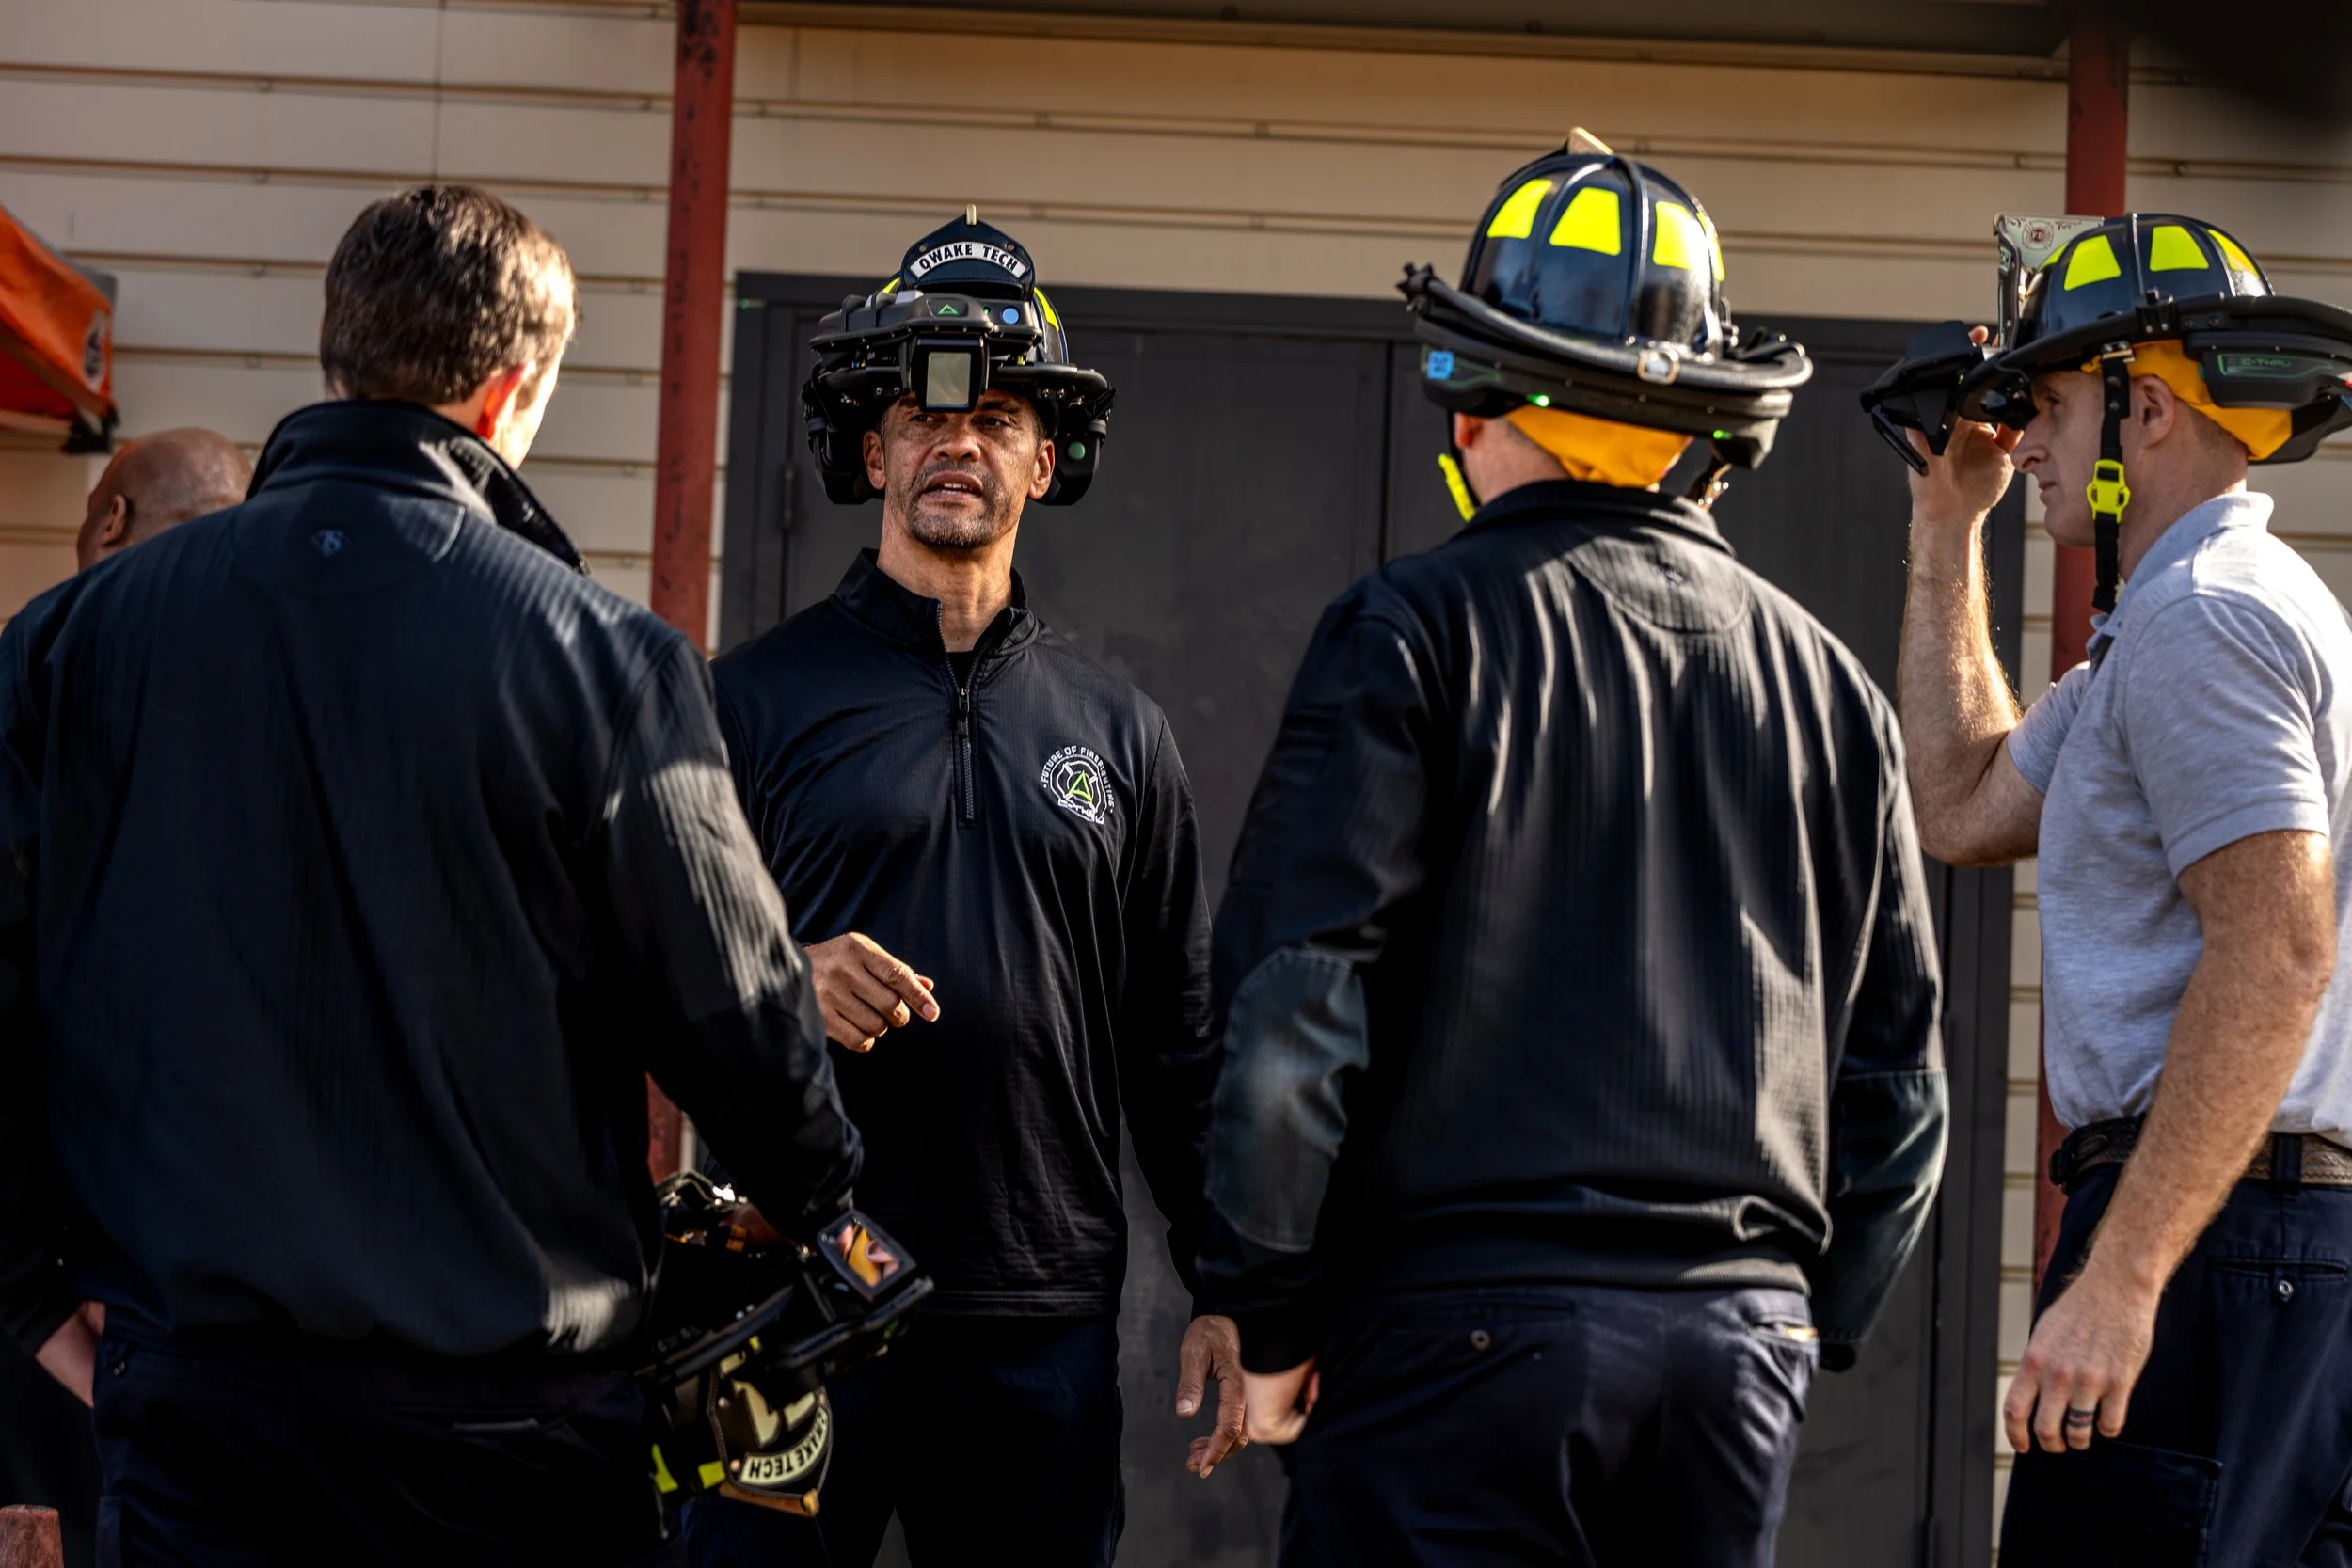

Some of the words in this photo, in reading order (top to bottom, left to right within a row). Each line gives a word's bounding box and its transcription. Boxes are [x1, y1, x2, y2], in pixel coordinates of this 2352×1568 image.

[918, 244, 973, 271] QWAKE
[982, 245, 1018, 271] TECH
[1041, 751, 1063, 784] FUTURE
[1064, 745, 1077, 755] OF
[1080, 747, 1115, 808] FIREFIGHTING
[749, 1455, 793, 1478] TECH
